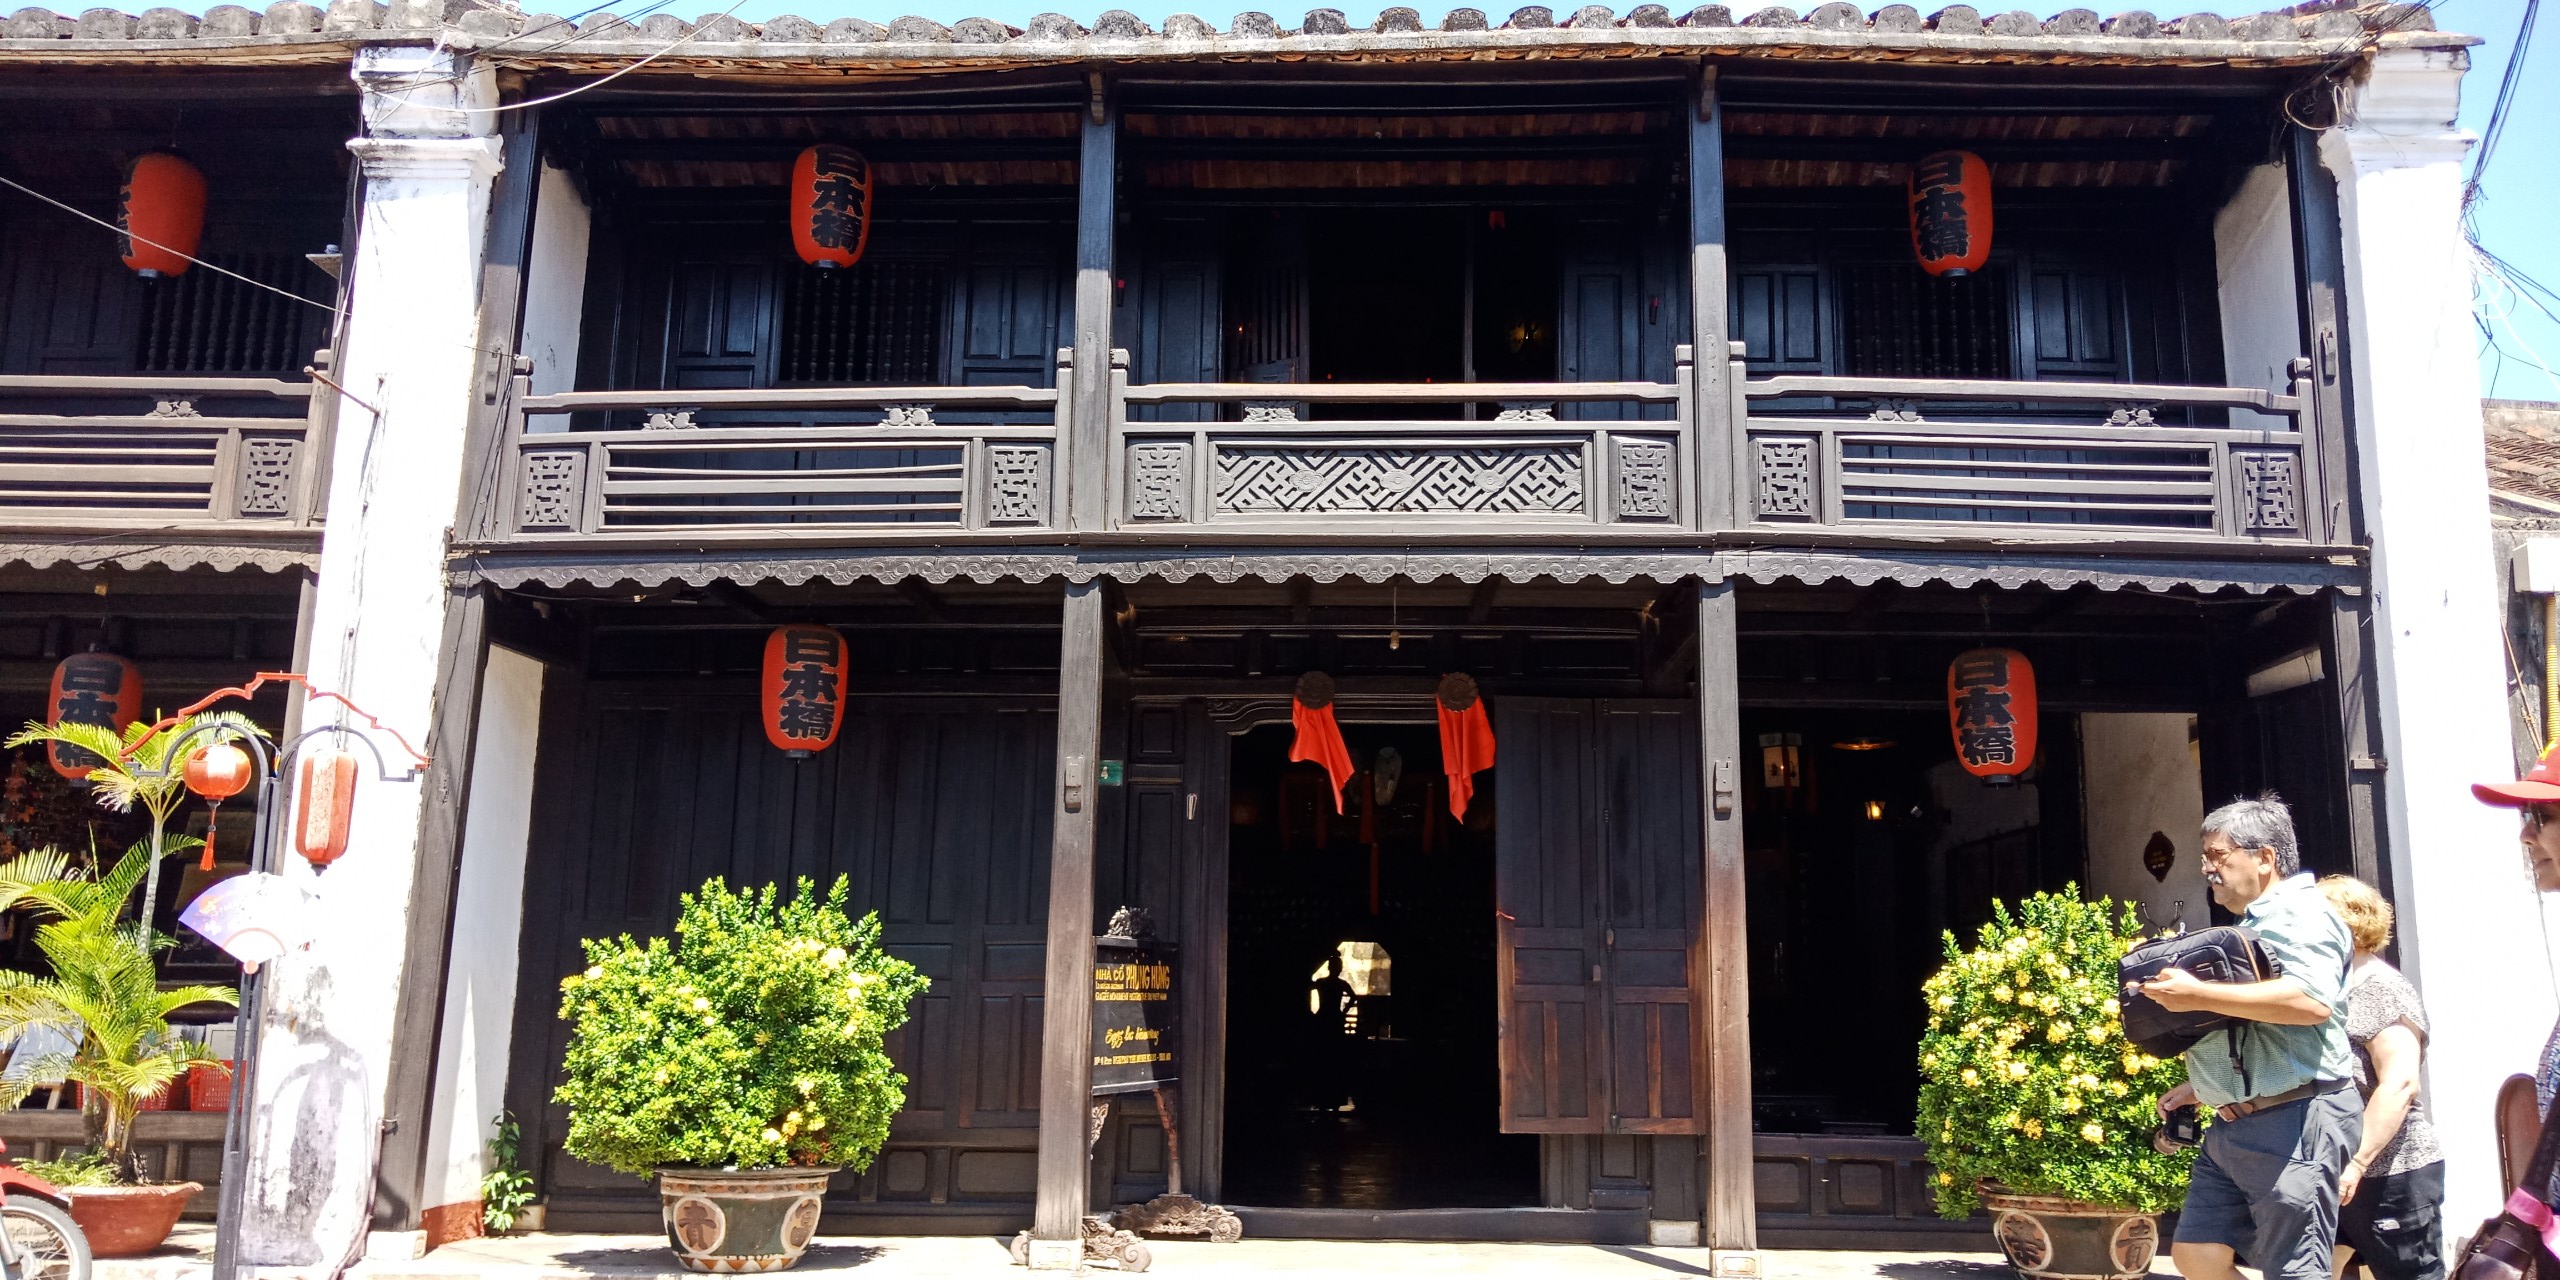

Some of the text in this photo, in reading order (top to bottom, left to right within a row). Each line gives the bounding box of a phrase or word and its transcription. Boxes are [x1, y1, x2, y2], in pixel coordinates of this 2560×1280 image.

[779, 629, 840, 742] 日本橋
[1954, 653, 2017, 767] 日本橋
[1095, 966, 1112, 981] NHÀ
[1113, 963, 1125, 981] CỔ
